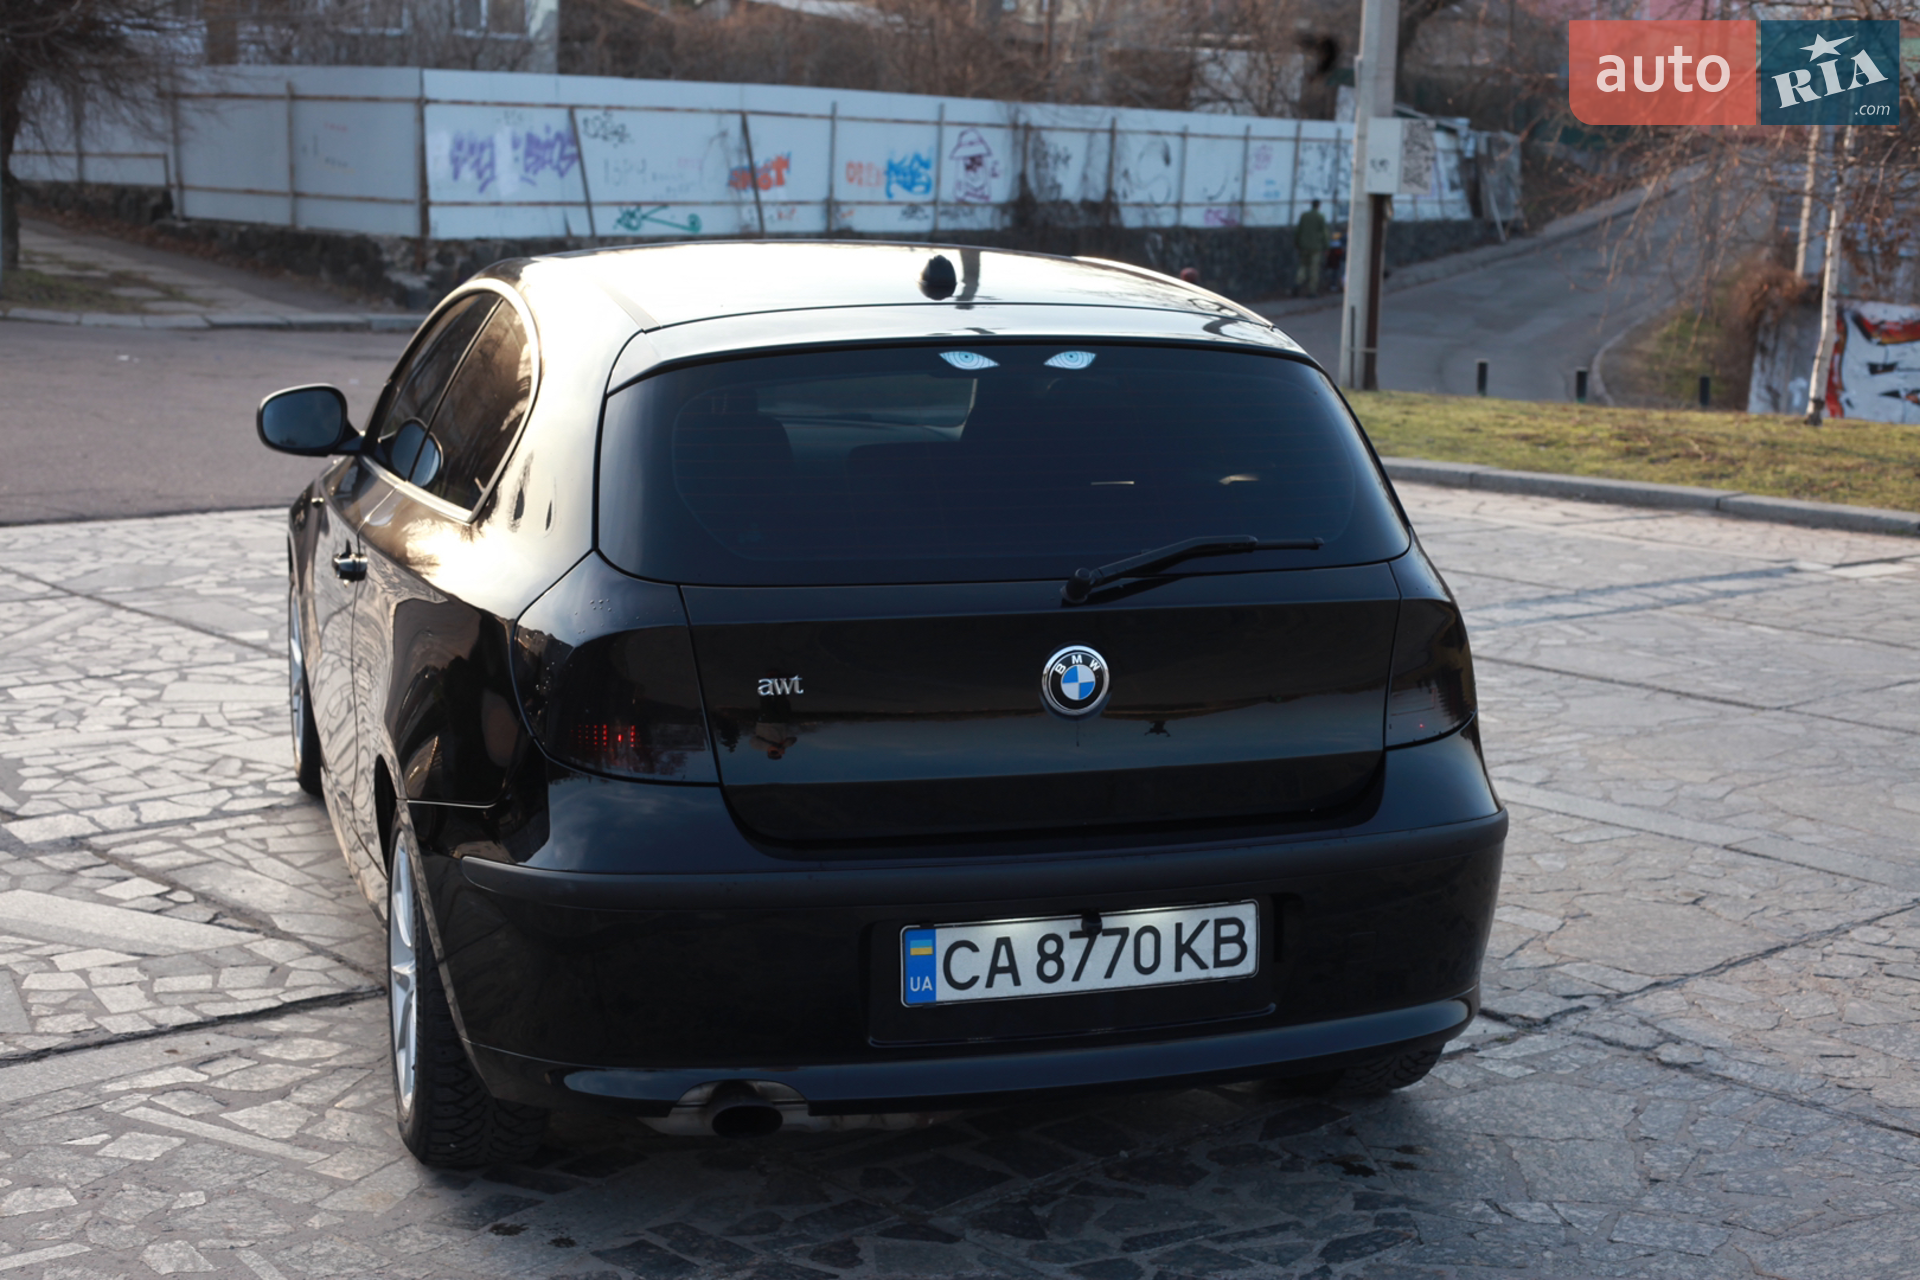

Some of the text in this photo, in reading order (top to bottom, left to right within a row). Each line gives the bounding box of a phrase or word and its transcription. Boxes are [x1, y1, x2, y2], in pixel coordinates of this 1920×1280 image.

[1054, 654, 1101, 675] BMW
[757, 675, 804, 696] awt
[942, 917, 1248, 991] CA 8770 KB
[909, 976, 933, 992] UA
